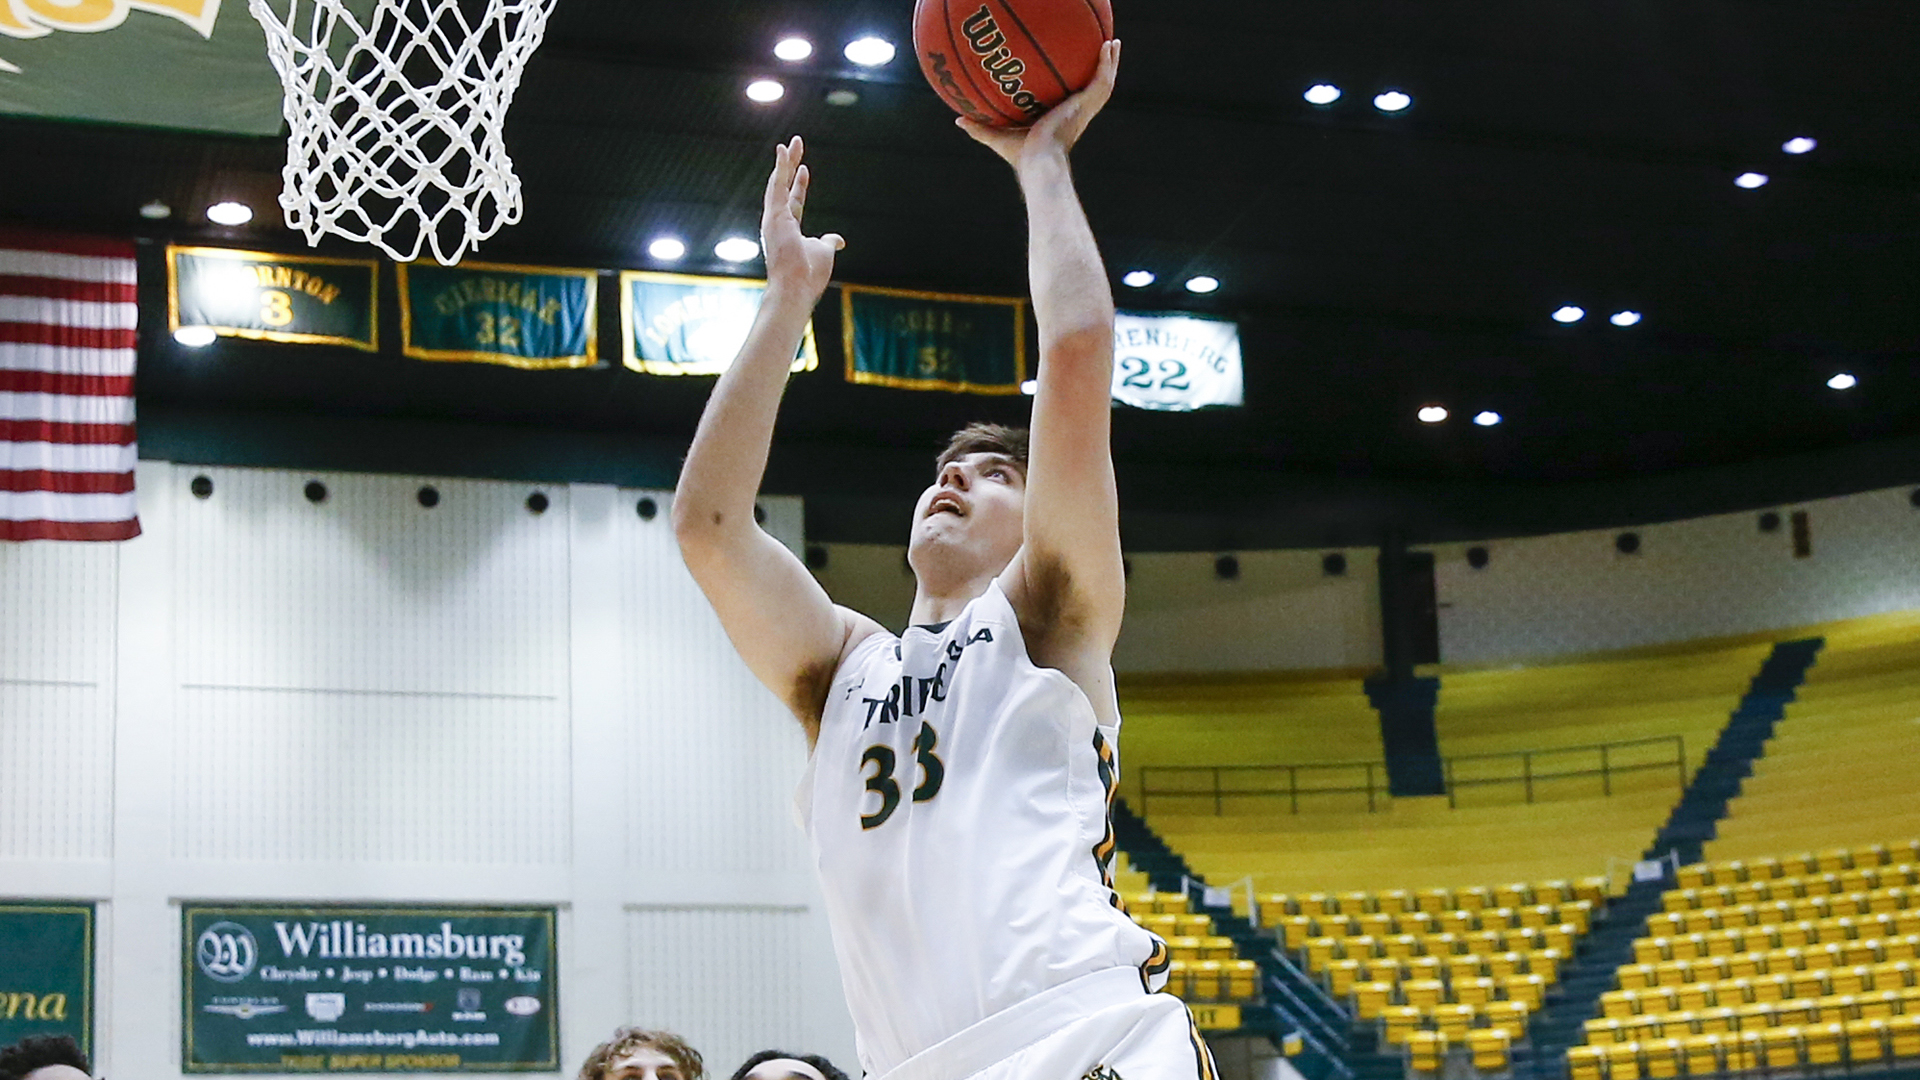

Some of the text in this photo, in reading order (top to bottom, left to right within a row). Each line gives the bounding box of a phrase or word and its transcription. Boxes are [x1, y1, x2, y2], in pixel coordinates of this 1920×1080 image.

[260, 289, 294, 327] 3
[475, 311, 521, 349] 32
[1120, 355, 1191, 391] 22
[858, 720, 945, 831] 33
[274, 919, 526, 967] Williamsburg
